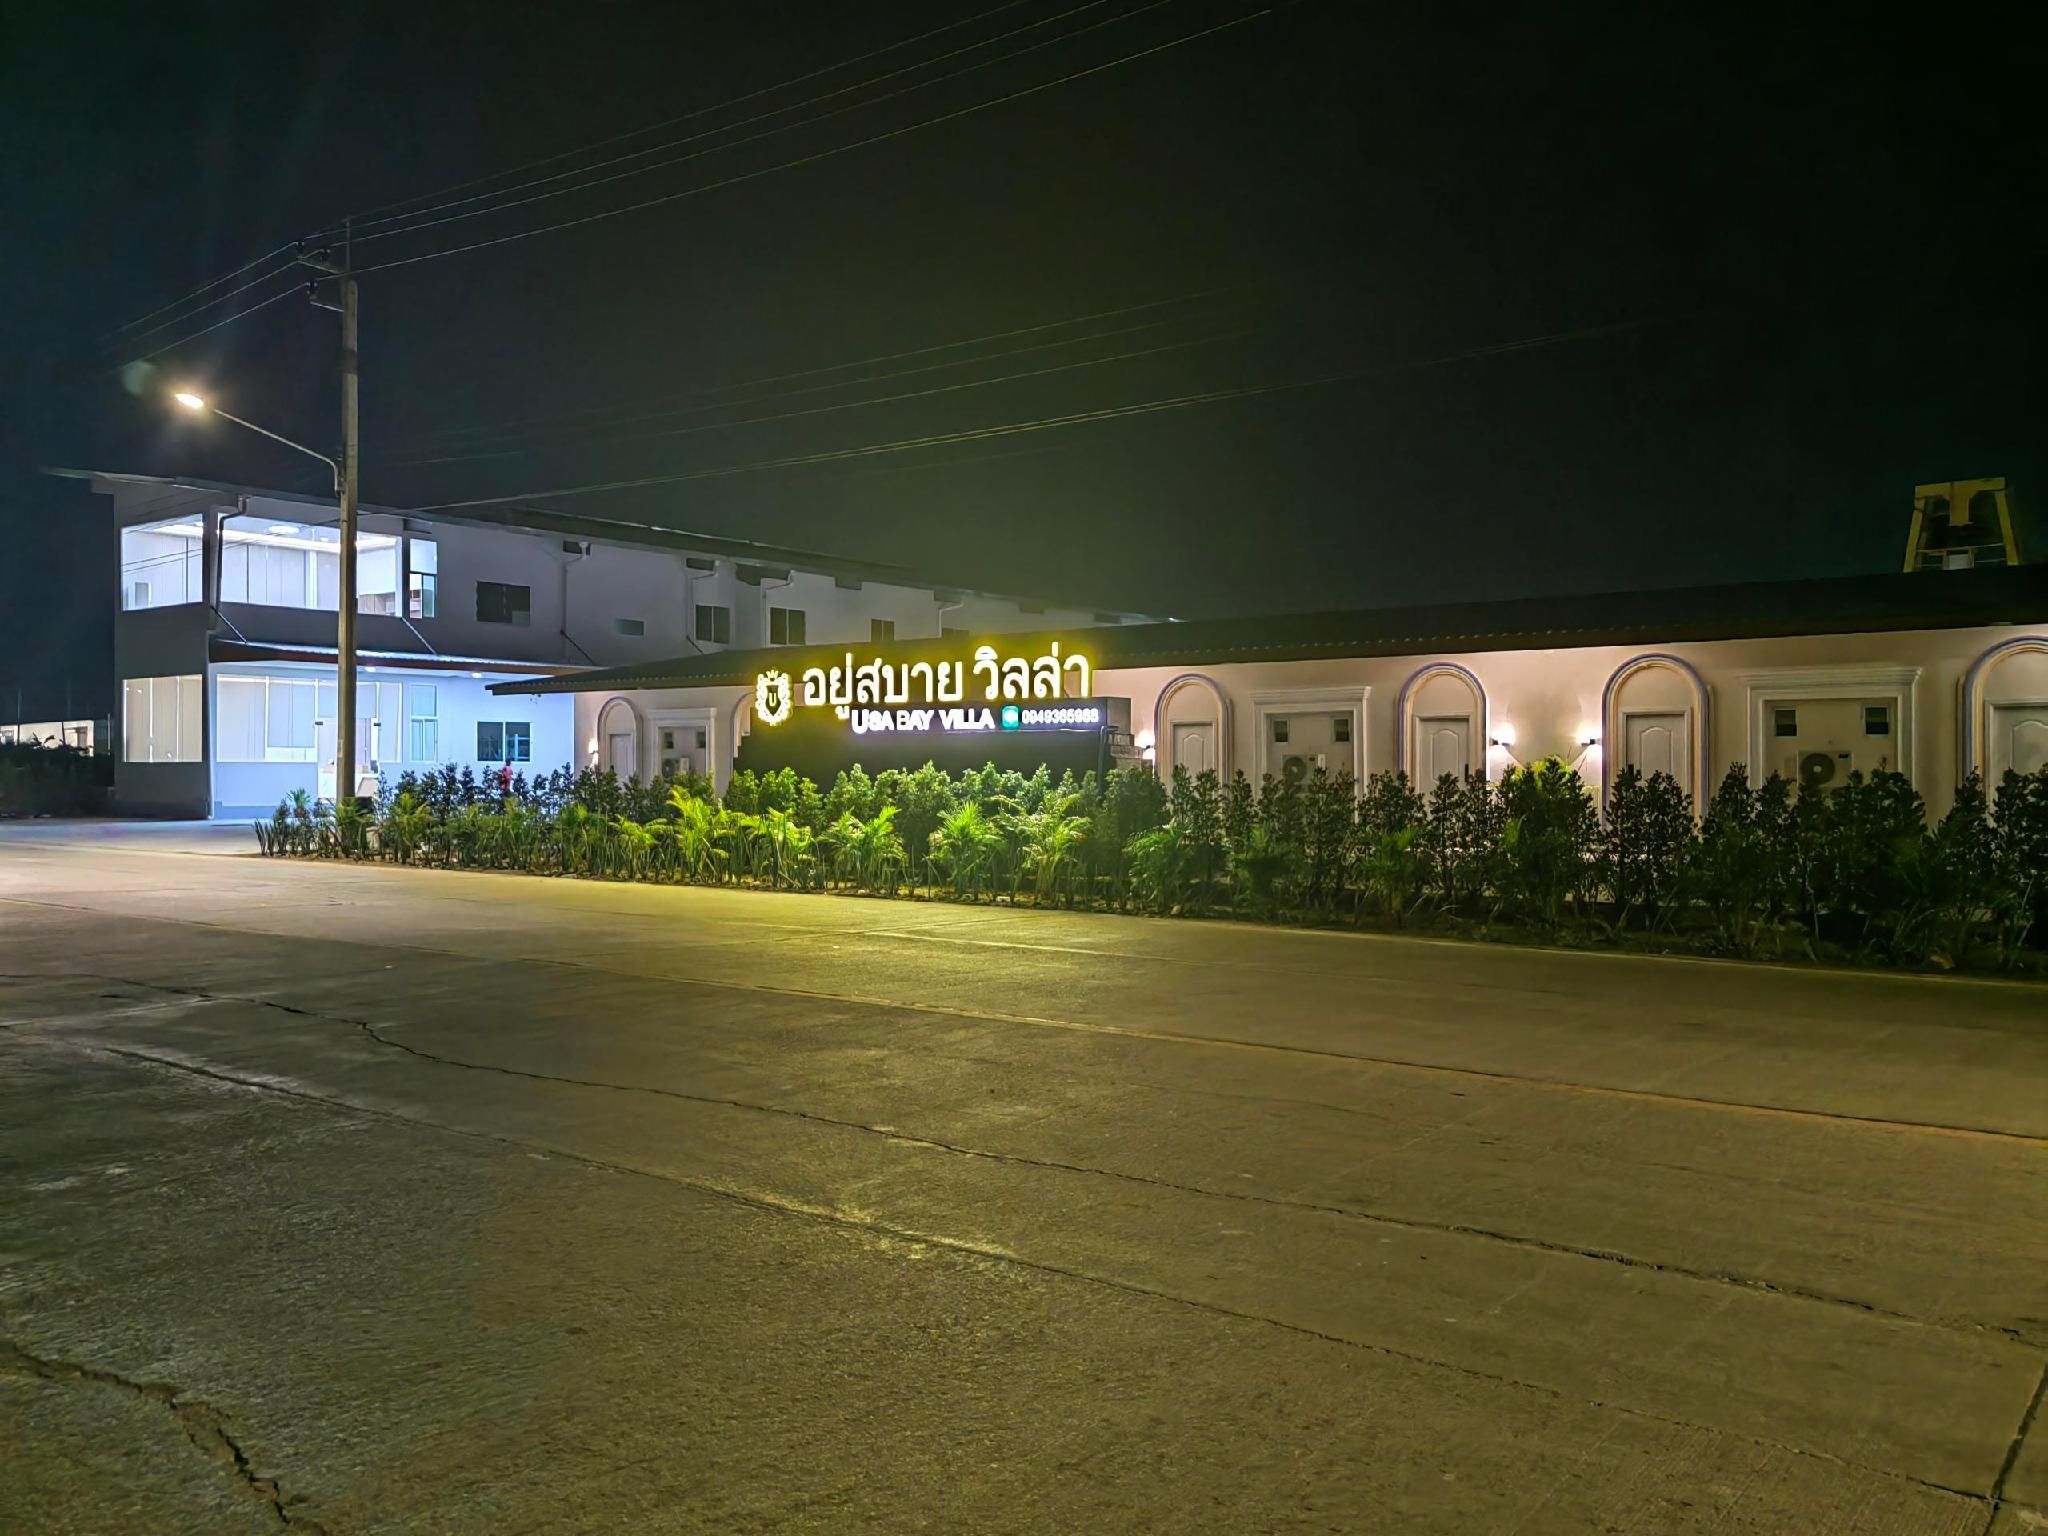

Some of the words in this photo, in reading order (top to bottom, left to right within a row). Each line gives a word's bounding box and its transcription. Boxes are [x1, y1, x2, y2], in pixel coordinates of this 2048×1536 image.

[803, 652, 962, 719] อยู่สบาย
[973, 641, 1089, 700] วิลล่า
[896, 710, 934, 731] BAY
[939, 708, 995, 730] VILLA
